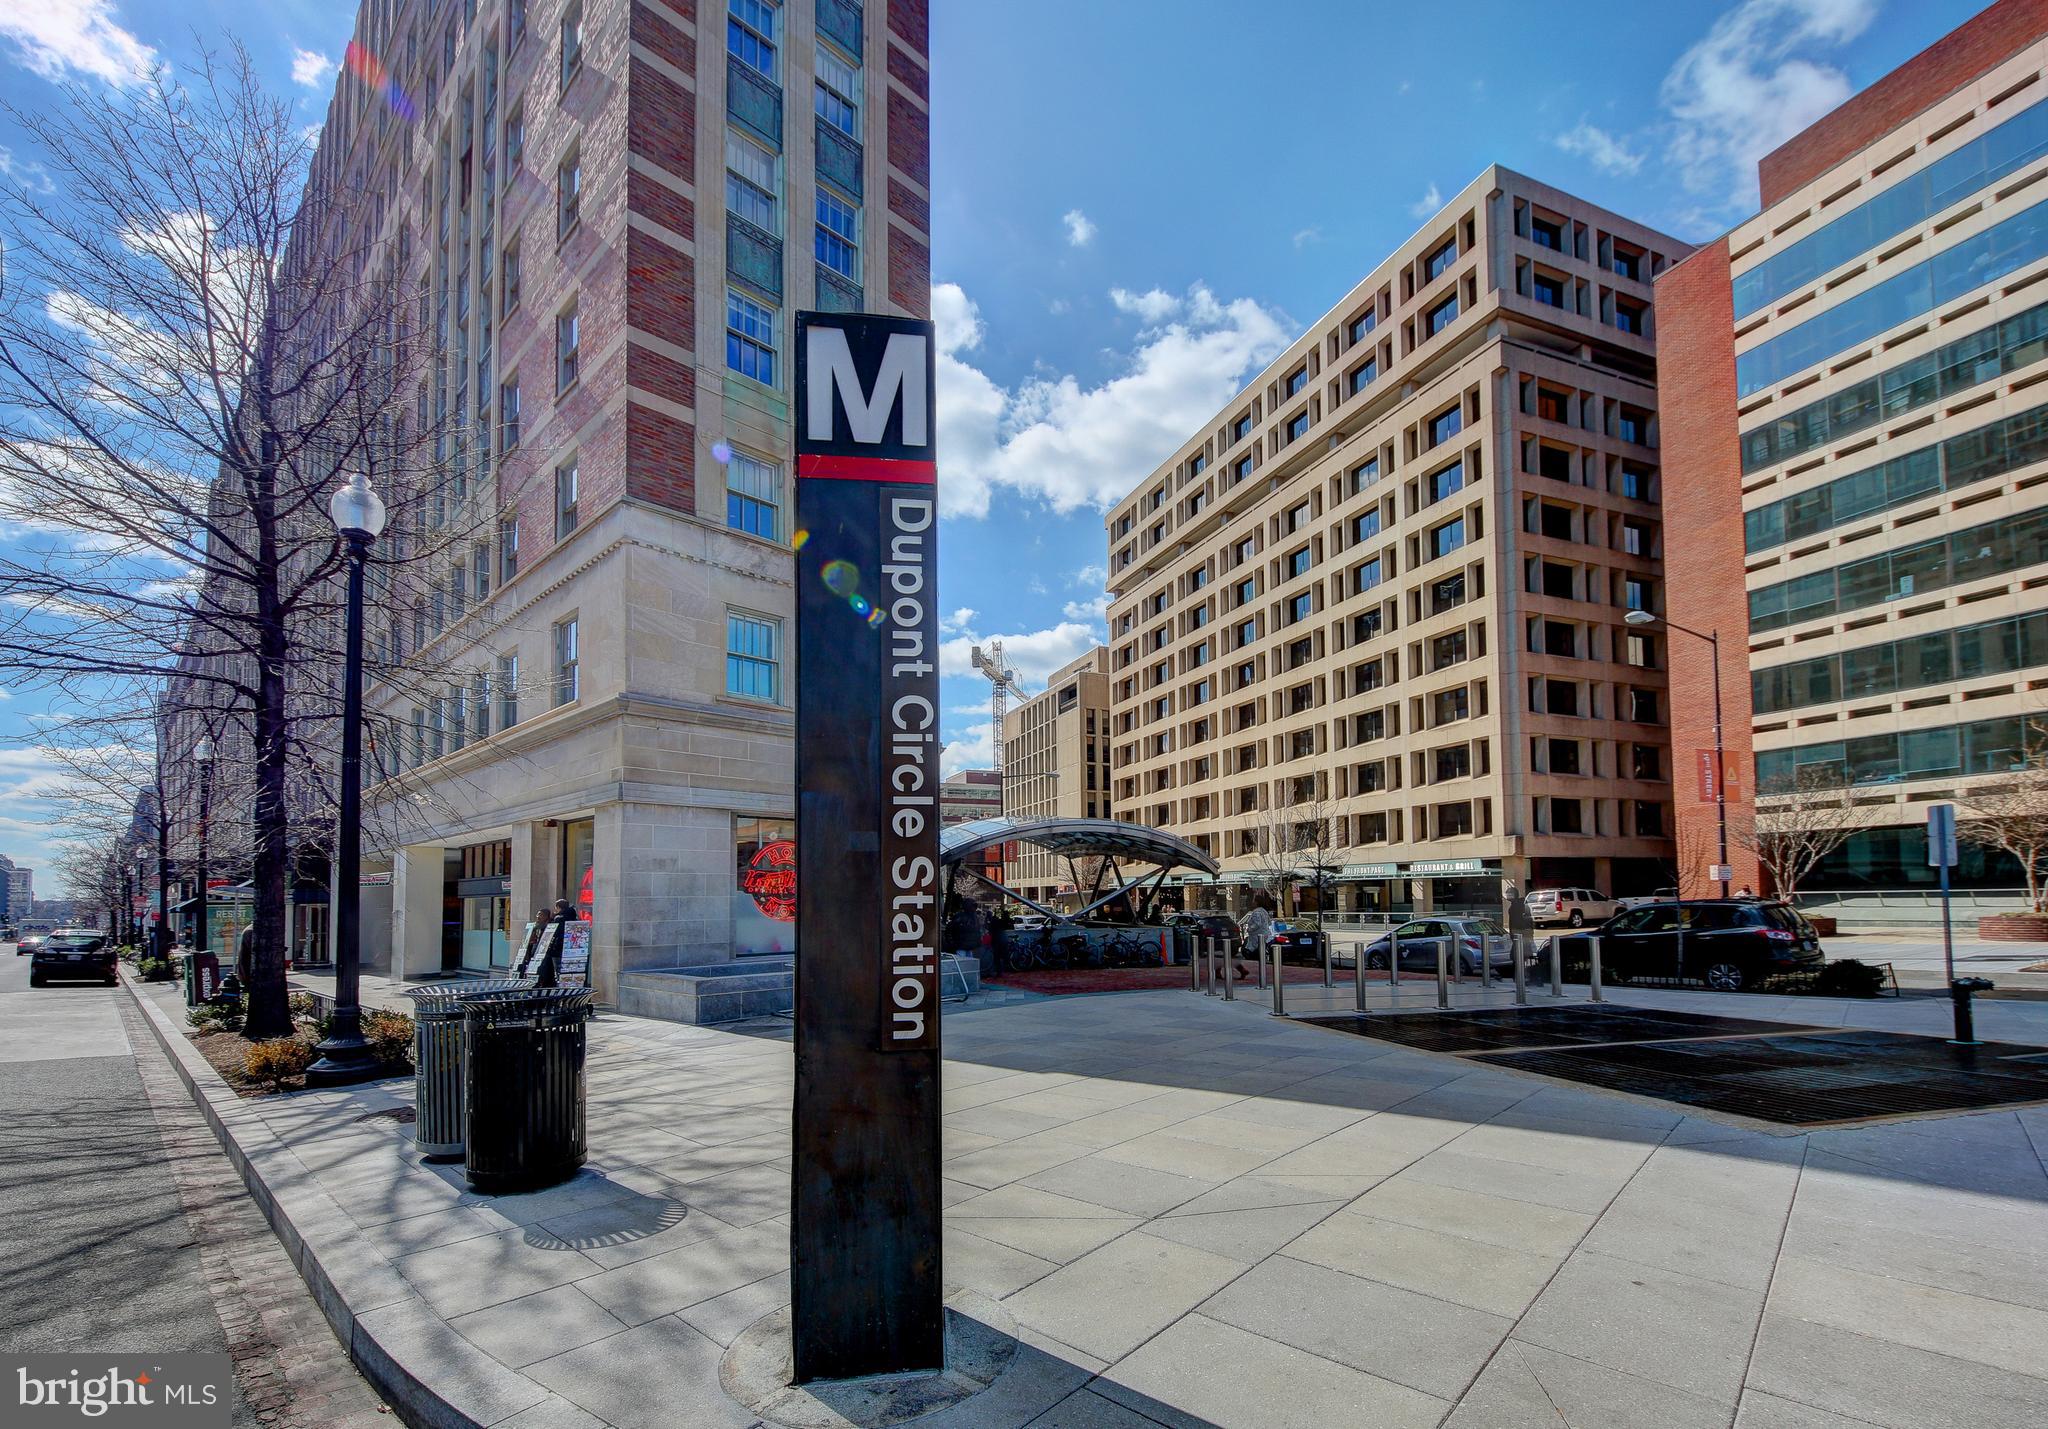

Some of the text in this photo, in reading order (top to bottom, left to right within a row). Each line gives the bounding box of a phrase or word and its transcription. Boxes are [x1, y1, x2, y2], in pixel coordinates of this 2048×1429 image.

[807, 325, 927, 447] M
[882, 497, 935, 1041] Dupont Circle Station
[767, 847, 795, 862] HO
[1409, 864, 1449, 873] RESTAURANT
[1455, 862, 1474, 871] GRILL
[202, 967, 213, 998] express
